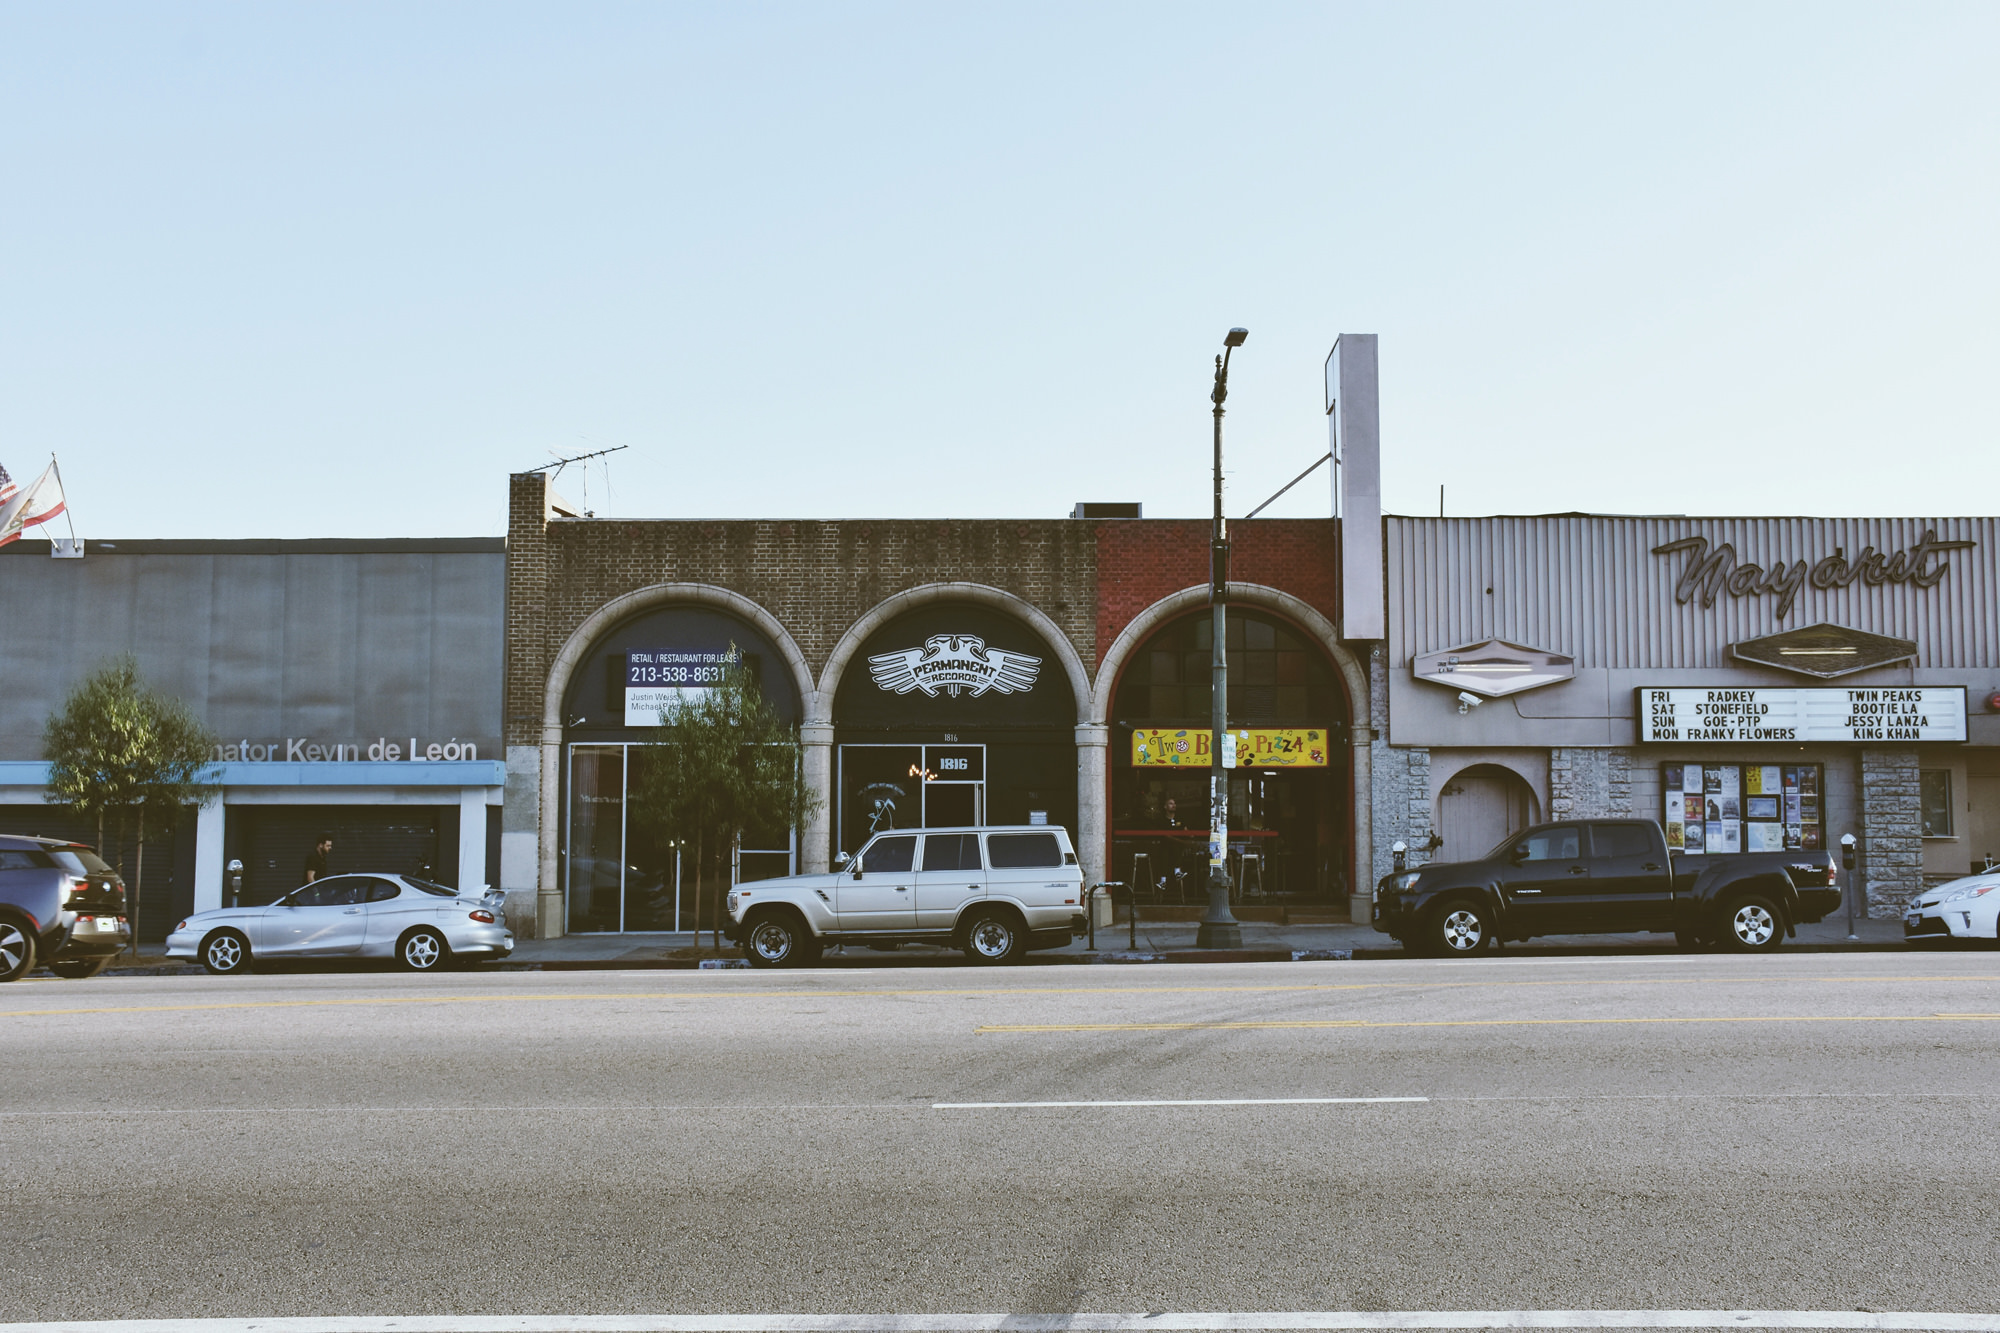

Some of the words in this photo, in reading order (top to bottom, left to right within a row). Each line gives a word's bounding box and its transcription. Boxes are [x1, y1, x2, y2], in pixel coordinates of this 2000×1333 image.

[1652, 530, 1976, 620] Nayarit
[631, 654, 653, 663] RETAIL
[660, 653, 702, 663] RESTAURANT
[703, 653, 716, 663] FOR
[717, 653, 737, 663] LEASE
[631, 666, 726, 682] 213-538-8631
[913, 659, 997, 678] PERMANENT
[931, 672, 977, 682] RECORDS
[631, 693, 653, 701] Justin
[1651, 691, 1670, 702] FRI
[1707, 691, 1755, 702] RADKEY
[1848, 690, 1878, 702] TWIN
[1883, 690, 1922, 702] PEAKS
[1652, 704, 1676, 715] SAT
[1695, 703, 1769, 715] STONEFIELD
[1853, 703, 1898, 715] BOOTIE
[1902, 703, 1918, 715] LA
[1652, 716, 1675, 727] SUN
[1844, 715, 1882, 727] JESSY
[1888, 715, 1929, 727] LANZA
[944, 733, 958, 742] 1816
[1653, 729, 1679, 740] MON
[1687, 728, 1735, 740] FRANKY
[1739, 728, 1796, 740] FLOWERS
[1853, 728, 1883, 740] KING
[1887, 728, 1920, 740] KHAN
[286, 738, 359, 762] Kevin
[368, 738, 400, 761] de
[410, 737, 477, 761] León
[940, 758, 968, 770] 1816
